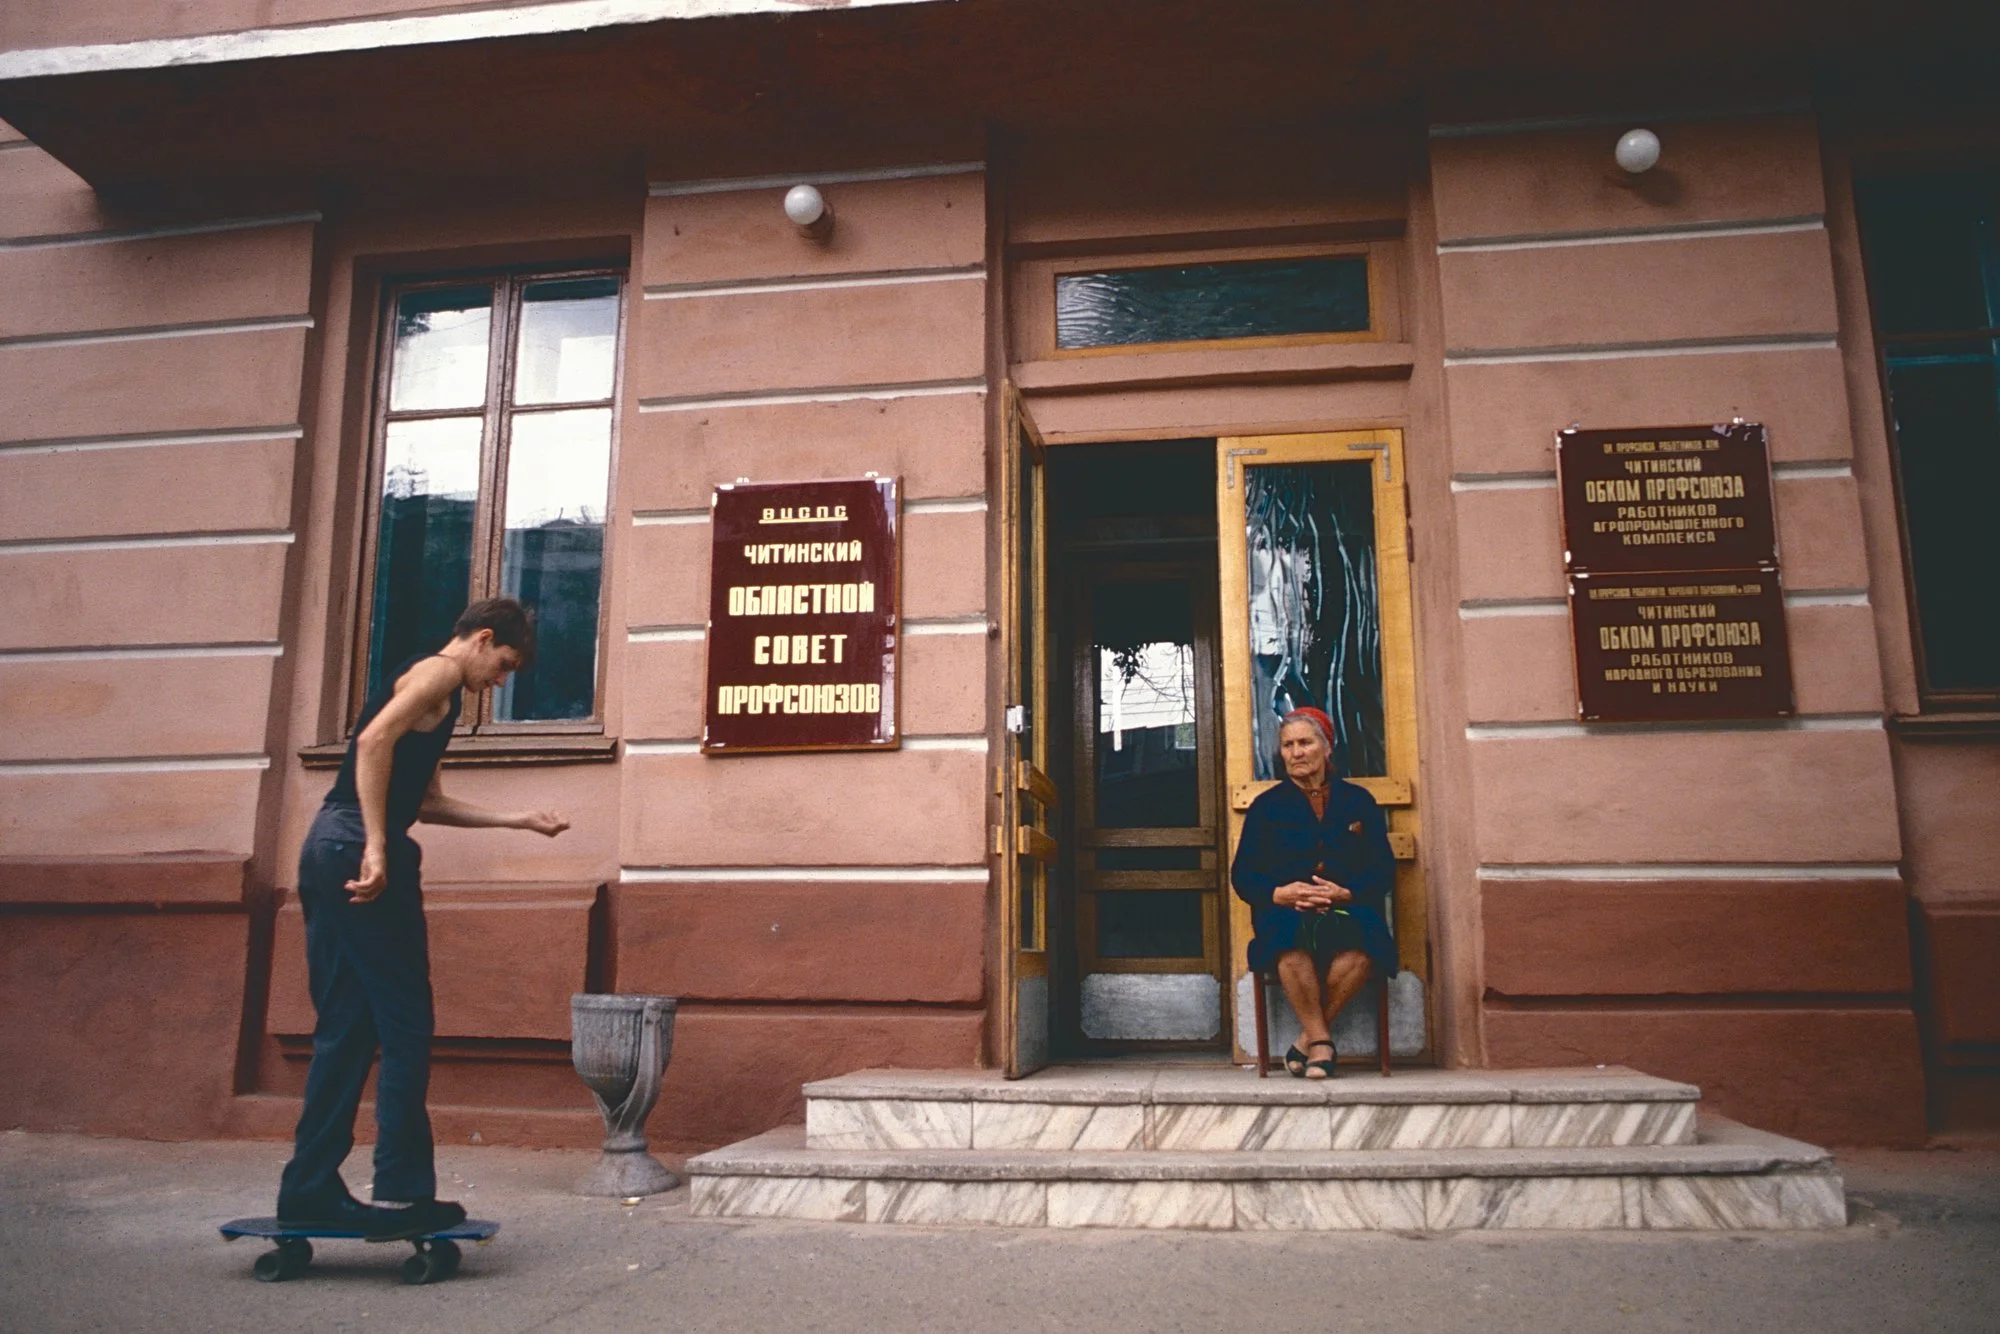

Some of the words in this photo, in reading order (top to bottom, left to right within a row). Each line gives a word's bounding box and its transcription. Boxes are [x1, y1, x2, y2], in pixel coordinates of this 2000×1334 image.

[1624, 456, 1701, 474] ЧИТИНСКИЙ
[1585, 479, 1640, 502] ОБКОМ
[1646, 476, 1744, 500] ПРОФСОЮЗА
[763, 505, 847, 520] ВЦСПС
[1618, 504, 1717, 518] РАБОТНИКОВ
[1593, 517, 1744, 532] АГРОПРОМЫШЛЕННОГО
[1623, 532, 1716, 545] КОМПЛЕКСА
[744, 540, 862, 564] ЧИТИНСКИЙ
[729, 581, 875, 616] ОБЛАСТНОЙ
[1638, 603, 1716, 619] ЧИТИНСКИЙ
[1600, 626, 1655, 650] ОБКОМ
[1661, 622, 1761, 648] ПРОФСОЮЗА
[754, 634, 847, 664] СОВЕТ
[1631, 652, 1733, 667] РАБОТНИКОВ
[1605, 668, 1673, 681] НАРОДНОГО
[1676, 666, 1762, 678] ОБРАЗОВАНИЯ
[1653, 683, 1661, 693] И
[1668, 681, 1718, 693] НАУКИ
[718, 683, 880, 714] ПРОФСОЮЗОВ
